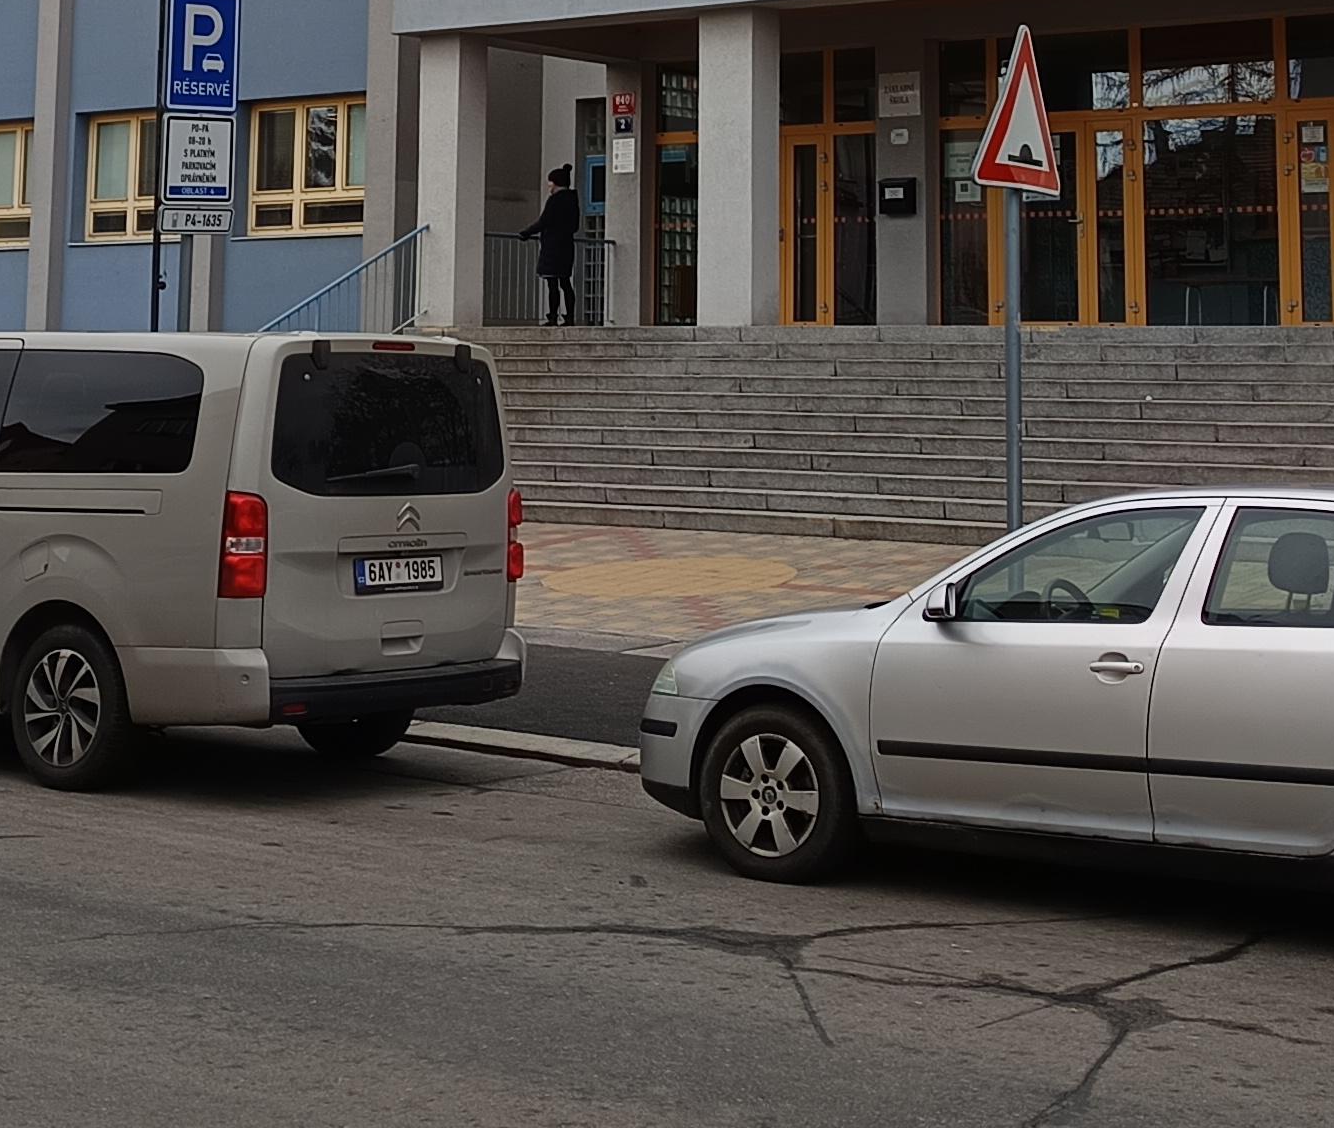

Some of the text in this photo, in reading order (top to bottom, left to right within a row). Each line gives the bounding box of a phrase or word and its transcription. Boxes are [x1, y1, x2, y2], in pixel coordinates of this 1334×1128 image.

[184, 3, 224, 72] P
[173, 77, 230, 97] RÉSERVÉ
[183, 147, 215, 158] S PLATNÝM
[368, 559, 436, 582] 6AY 1985
